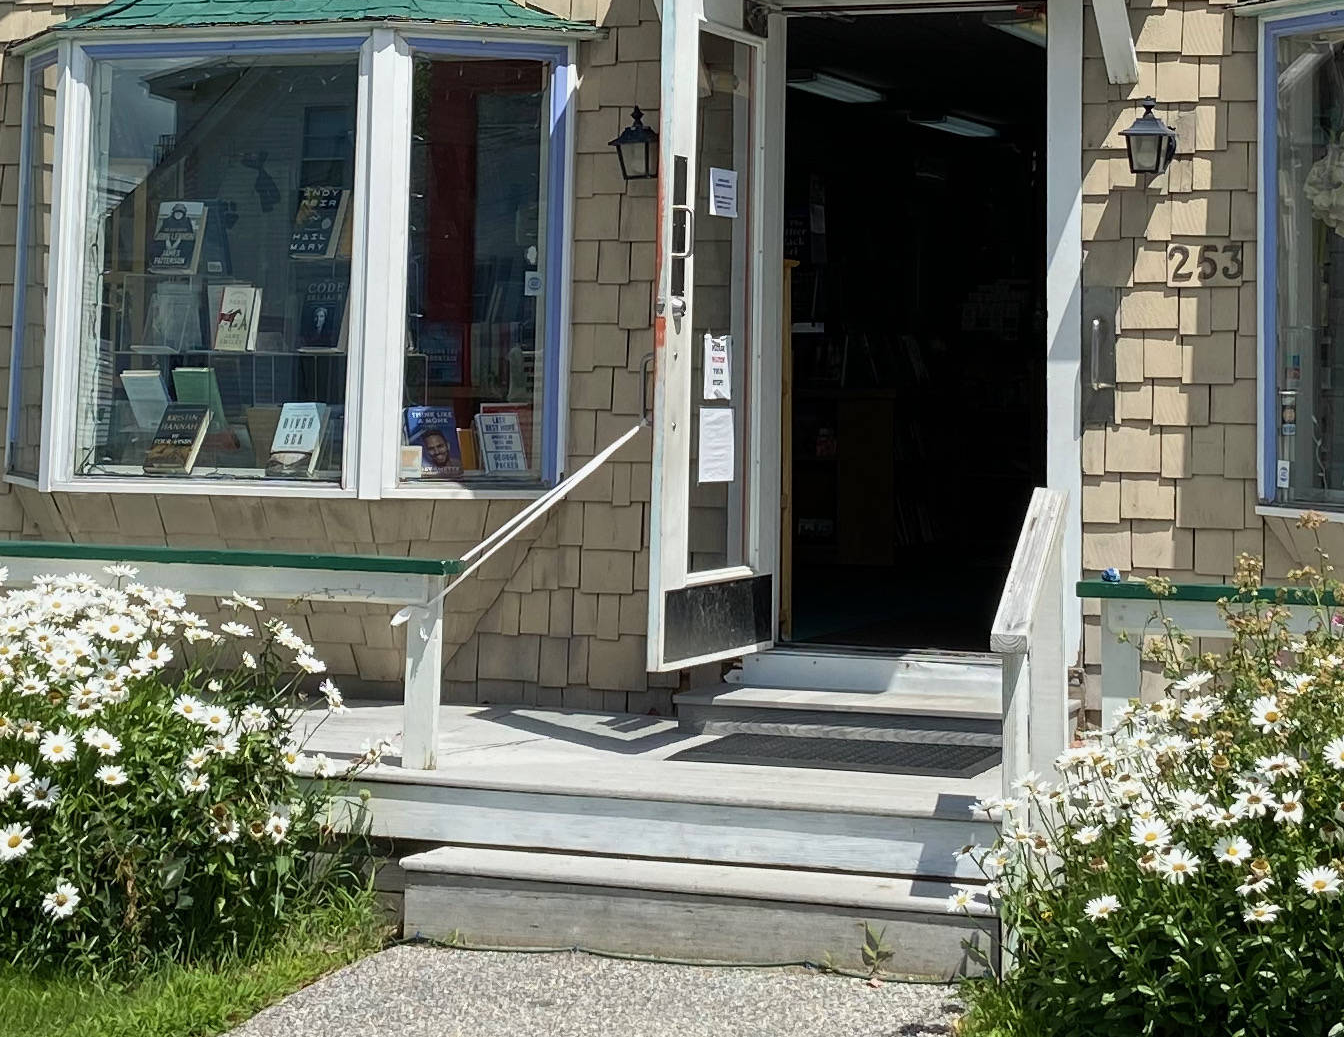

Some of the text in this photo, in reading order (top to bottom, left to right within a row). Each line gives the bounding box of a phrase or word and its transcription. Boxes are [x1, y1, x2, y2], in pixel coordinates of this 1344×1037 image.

[293, 233, 327, 241] HAIL
[1169, 245, 1243, 282] 253
[308, 283, 344, 294] CODE
